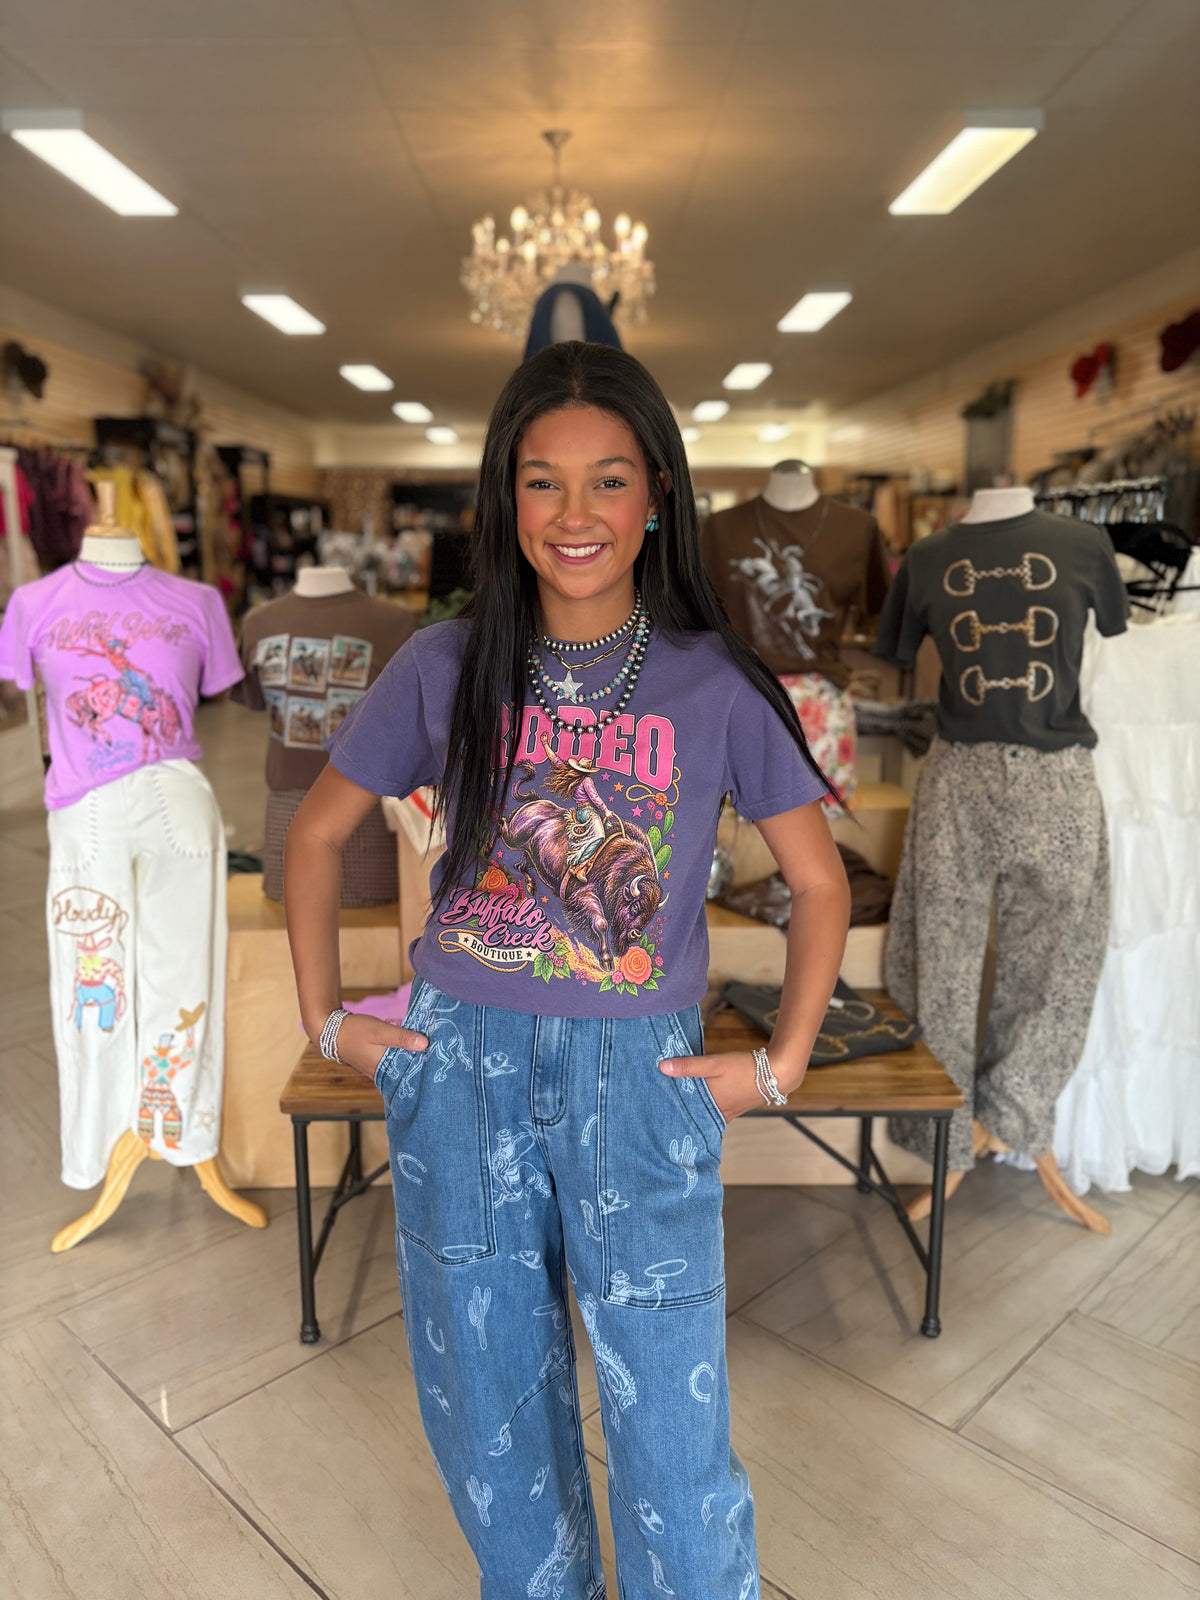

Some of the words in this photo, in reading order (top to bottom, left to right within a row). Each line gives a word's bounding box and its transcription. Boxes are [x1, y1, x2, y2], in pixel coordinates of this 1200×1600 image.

[53, 894, 119, 934] Howdy
[438, 887, 547, 928] Buffalo
[470, 938, 524, 962] BOUTIQUE
[482, 923, 555, 952] Creek
